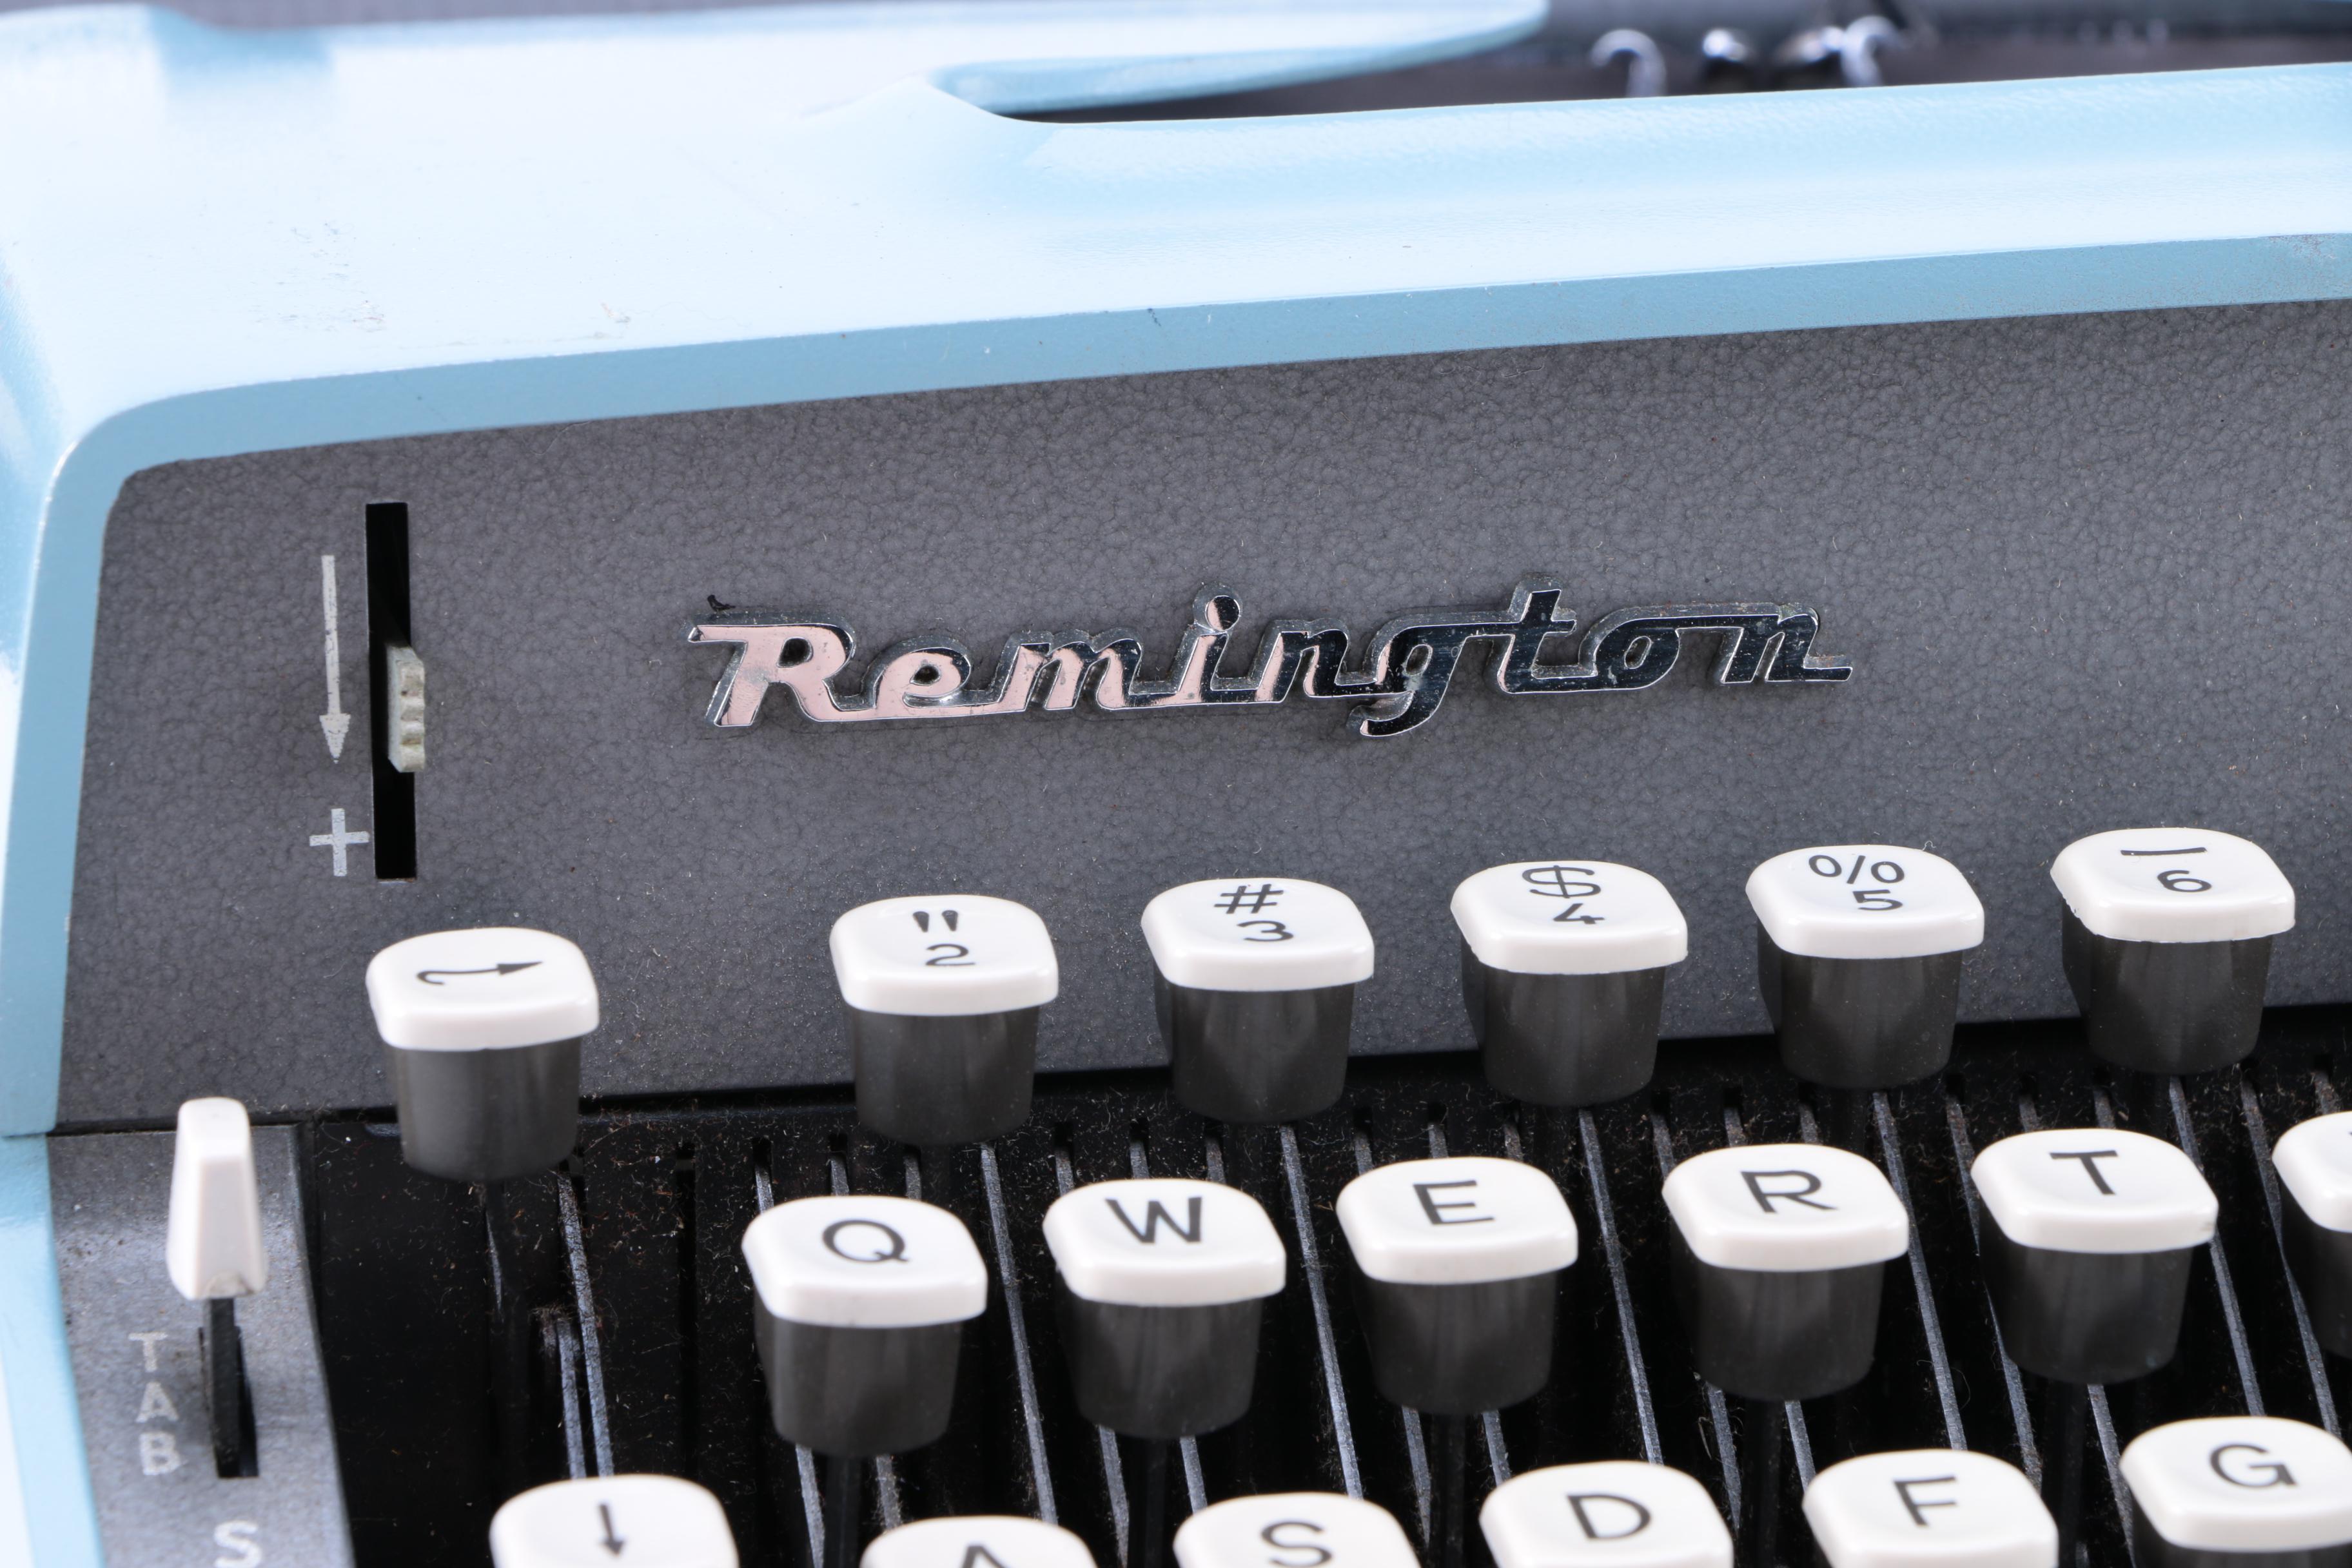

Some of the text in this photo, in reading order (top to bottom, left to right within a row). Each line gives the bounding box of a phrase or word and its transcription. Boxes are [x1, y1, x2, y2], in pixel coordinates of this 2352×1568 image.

[681, 582, 1853, 738] Remington
[1214, 883, 1284, 914] #
[1520, 864, 1601, 899] $
[1853, 890, 1902, 910] 5
[2157, 870, 2211, 892] 6
[1238, 921, 1293, 941] 3
[1554, 903, 1604, 924] 4
[926, 944, 973, 966] 2
[1741, 1171, 1832, 1212] R
[2050, 1150, 2117, 1195] T
[1106, 1197, 1201, 1243] W
[1414, 1181, 1493, 1224] E
[823, 1220, 906, 1262] Q
[128, 1331, 182, 1476] TAB
[2210, 1445, 2295, 1485] G
[1568, 1494, 1651, 1539] D
[1895, 1477, 1955, 1525] F
[1262, 1522, 1331, 1564] S
